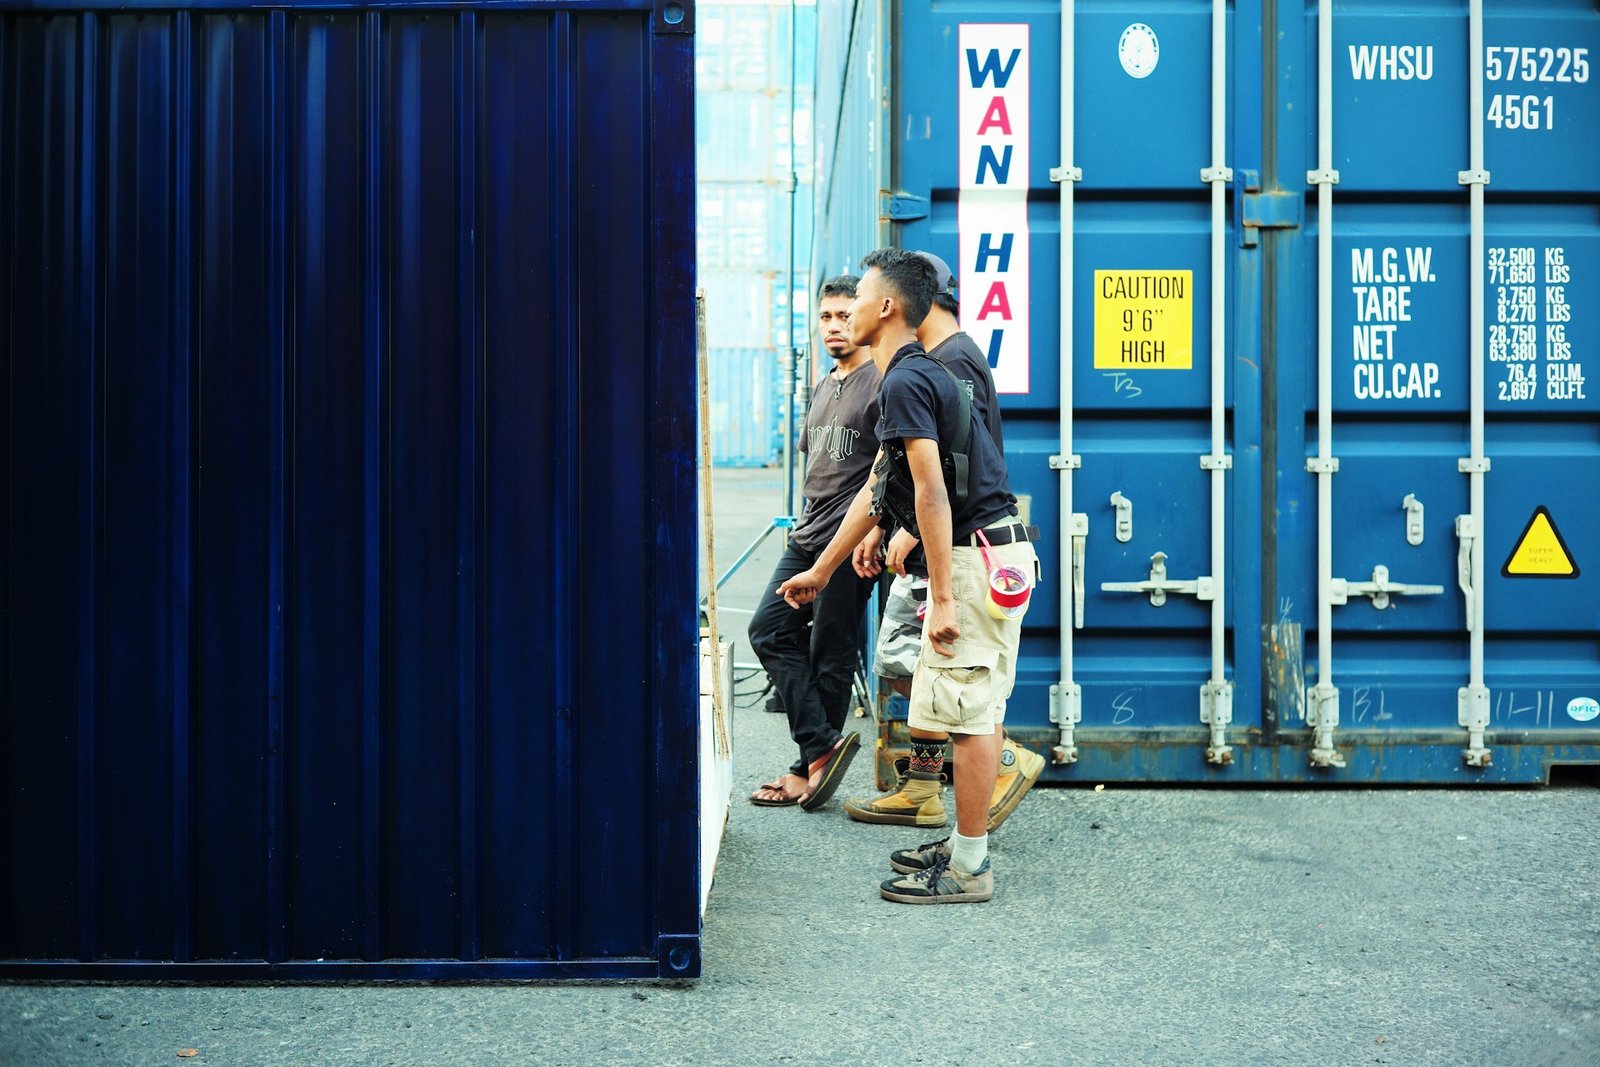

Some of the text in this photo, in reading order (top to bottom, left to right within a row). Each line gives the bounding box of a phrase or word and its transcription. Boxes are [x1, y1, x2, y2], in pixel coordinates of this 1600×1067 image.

[1348, 45, 1590, 84] WHSU 575225
[1487, 94, 1554, 130] 45G1
[966, 48, 1021, 369] WAN HAI
[1351, 247, 1436, 284] M.G.W.
[1488, 247, 1564, 267] 32,500 KG
[1488, 265, 1570, 285] 71,650 LBS
[1103, 276, 1184, 299] CAUTION
[1497, 286, 1565, 306] 3,750 KG
[1352, 286, 1412, 323] TARE
[1497, 304, 1571, 324] 8,270 LBS
[1353, 325, 1398, 361] NET
[1489, 325, 1565, 344] 28,750 KG
[1121, 340, 1165, 363] HIGH
[1489, 342, 1571, 362] 63,380 LBS
[1354, 362, 1442, 400] CU.CAP.
[1506, 363, 1537, 382] 76.4
[1498, 381, 1537, 401] 2,697
